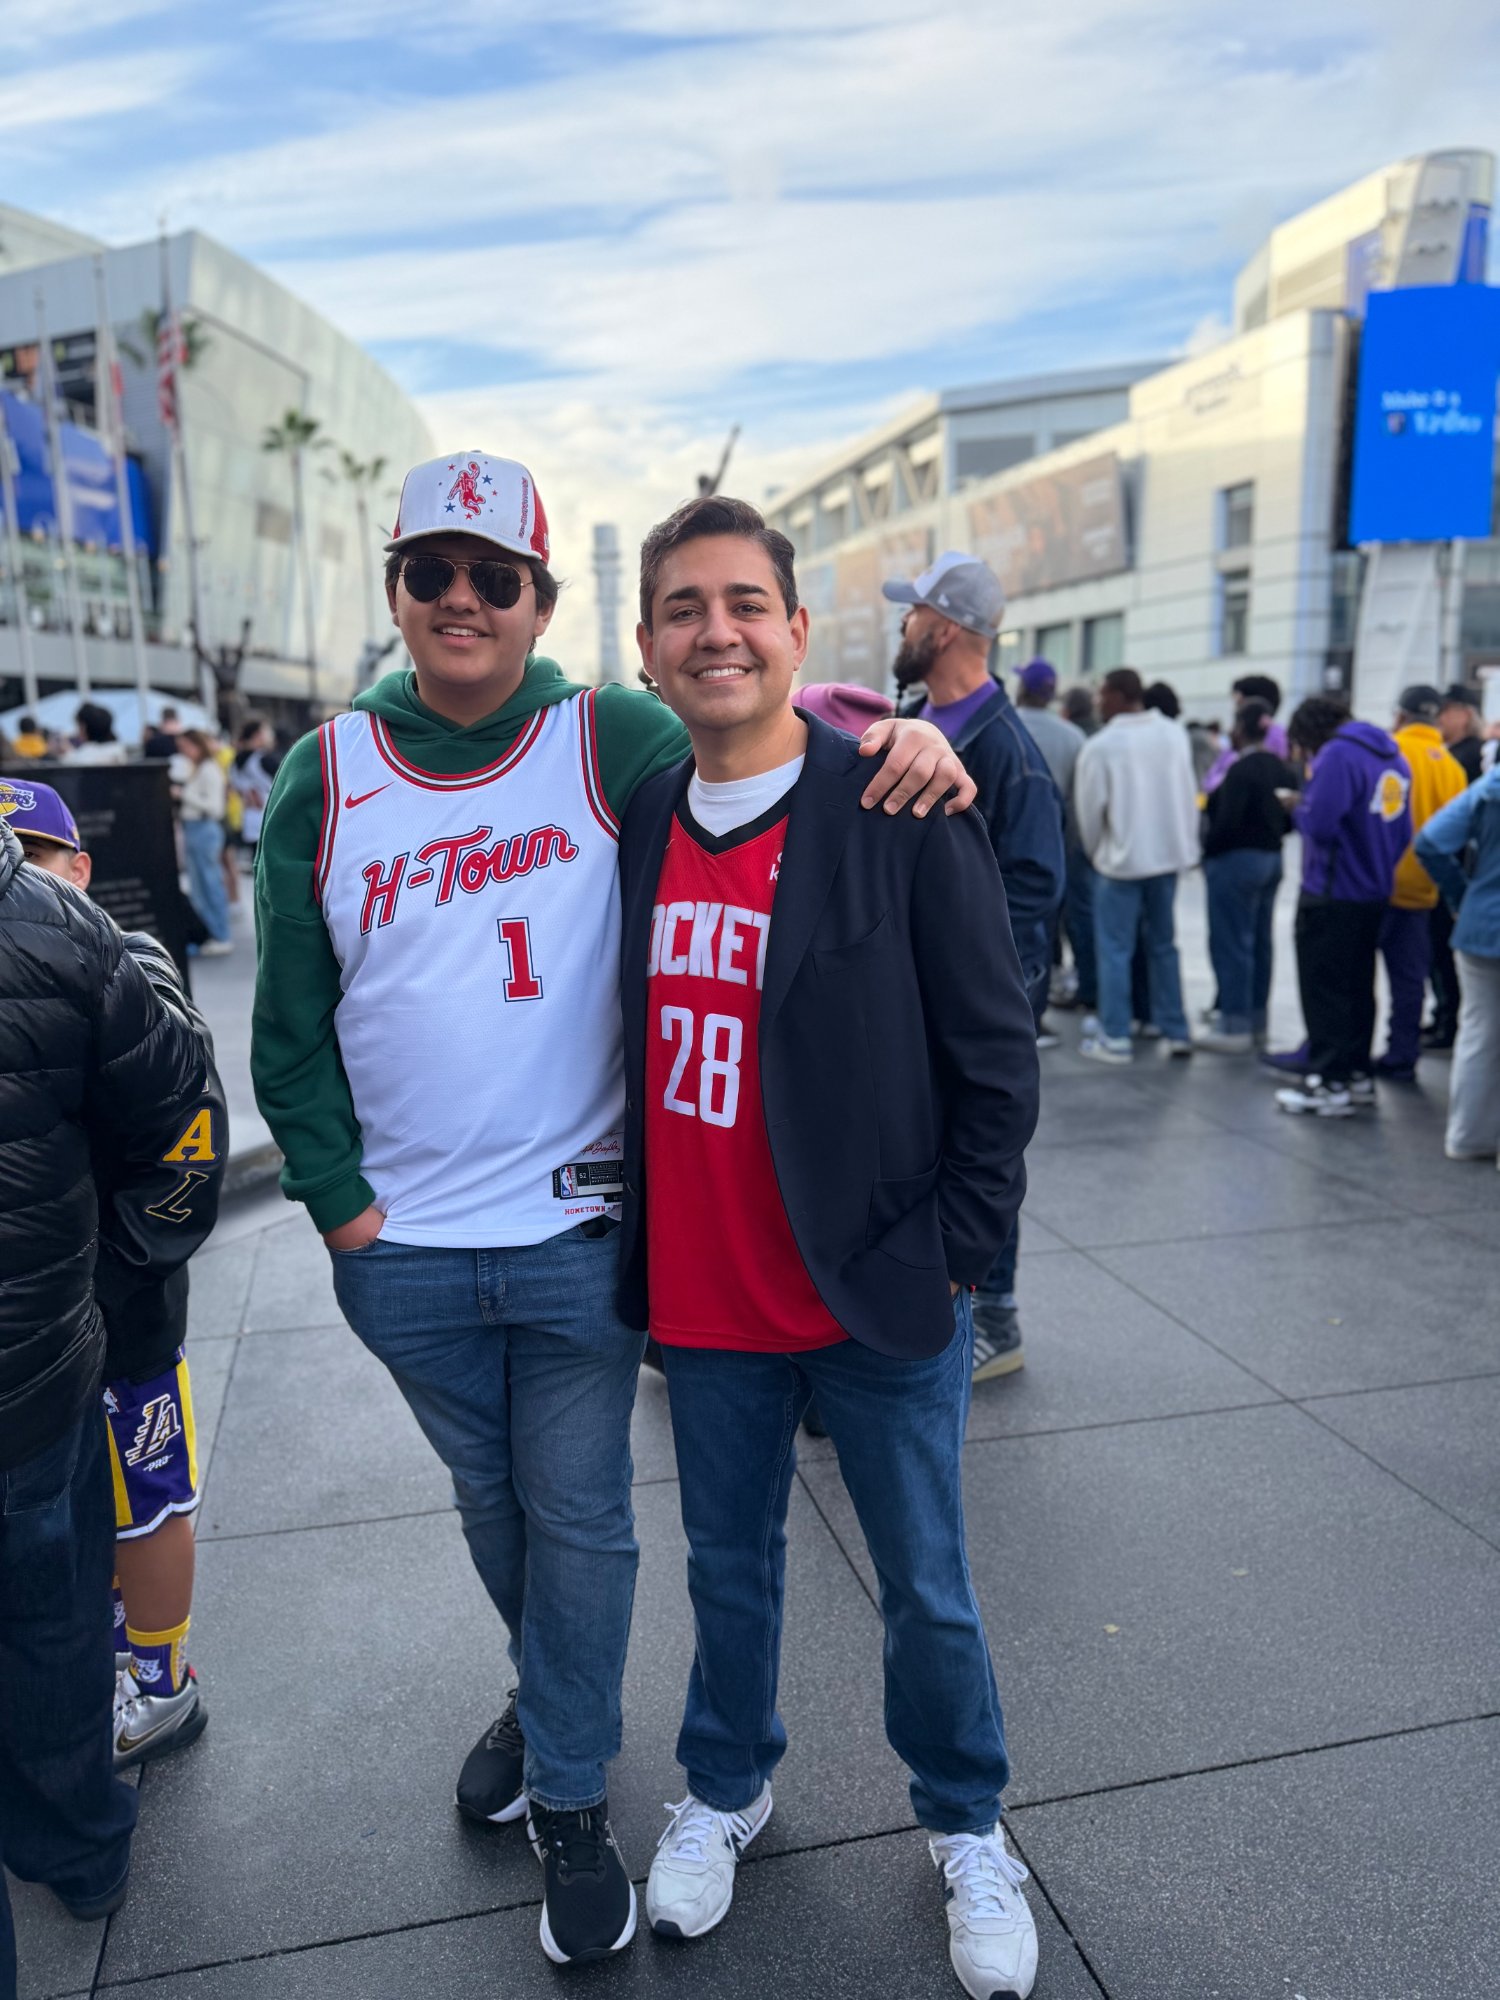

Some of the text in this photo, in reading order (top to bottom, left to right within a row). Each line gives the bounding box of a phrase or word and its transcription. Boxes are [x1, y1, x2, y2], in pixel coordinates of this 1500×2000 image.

[360, 824, 579, 936] H-Town
[497, 917, 543, 1001] 1
[660, 1005, 743, 1128] 28
[564, 1205, 606, 1215] HOMETOWN
